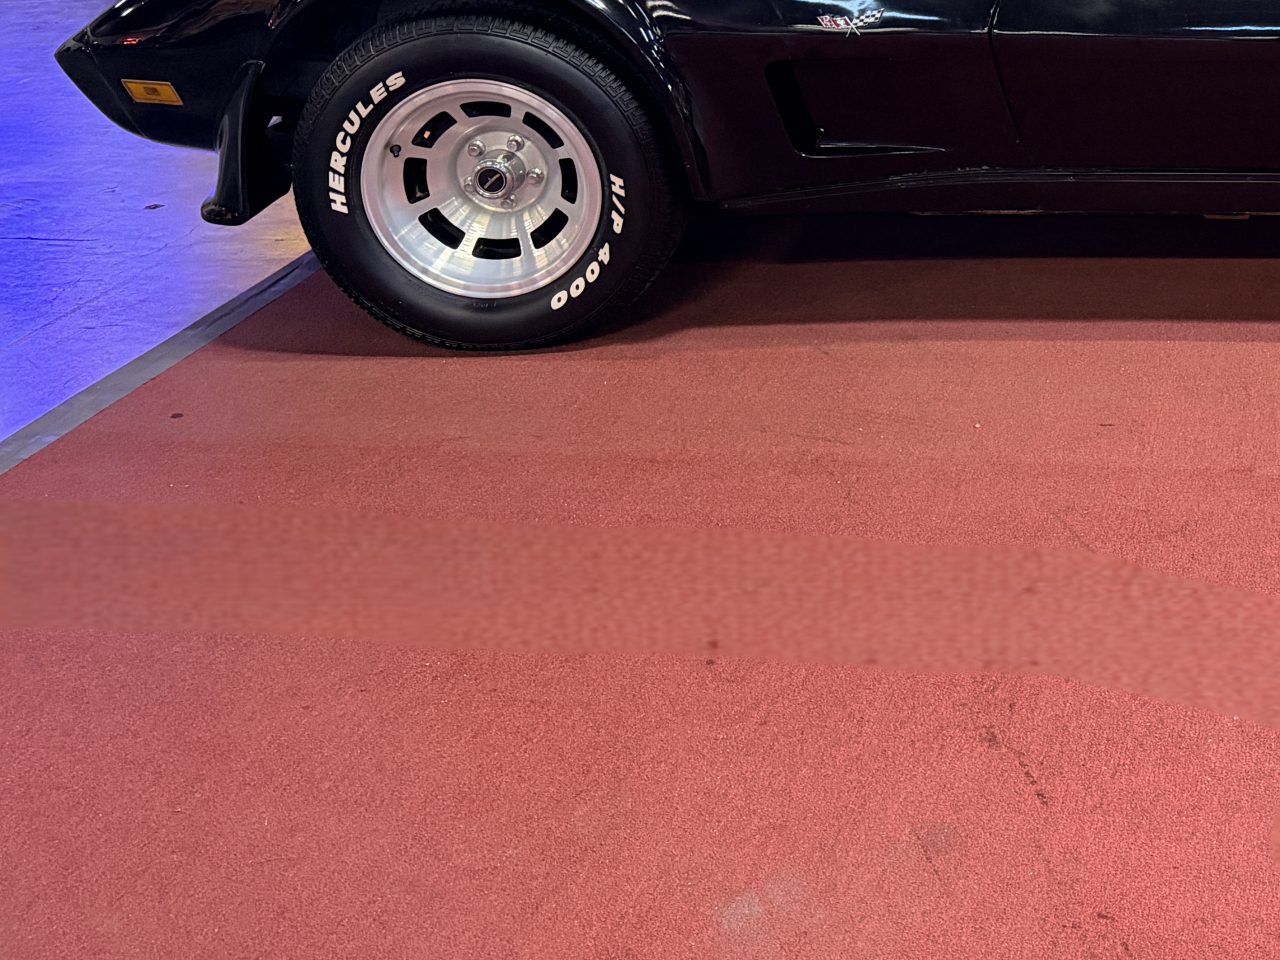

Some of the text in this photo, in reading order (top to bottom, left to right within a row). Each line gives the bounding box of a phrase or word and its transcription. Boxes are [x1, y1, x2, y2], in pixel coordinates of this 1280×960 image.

[328, 71, 406, 214] HERCULES
[550, 173, 626, 310] H/P 4000
